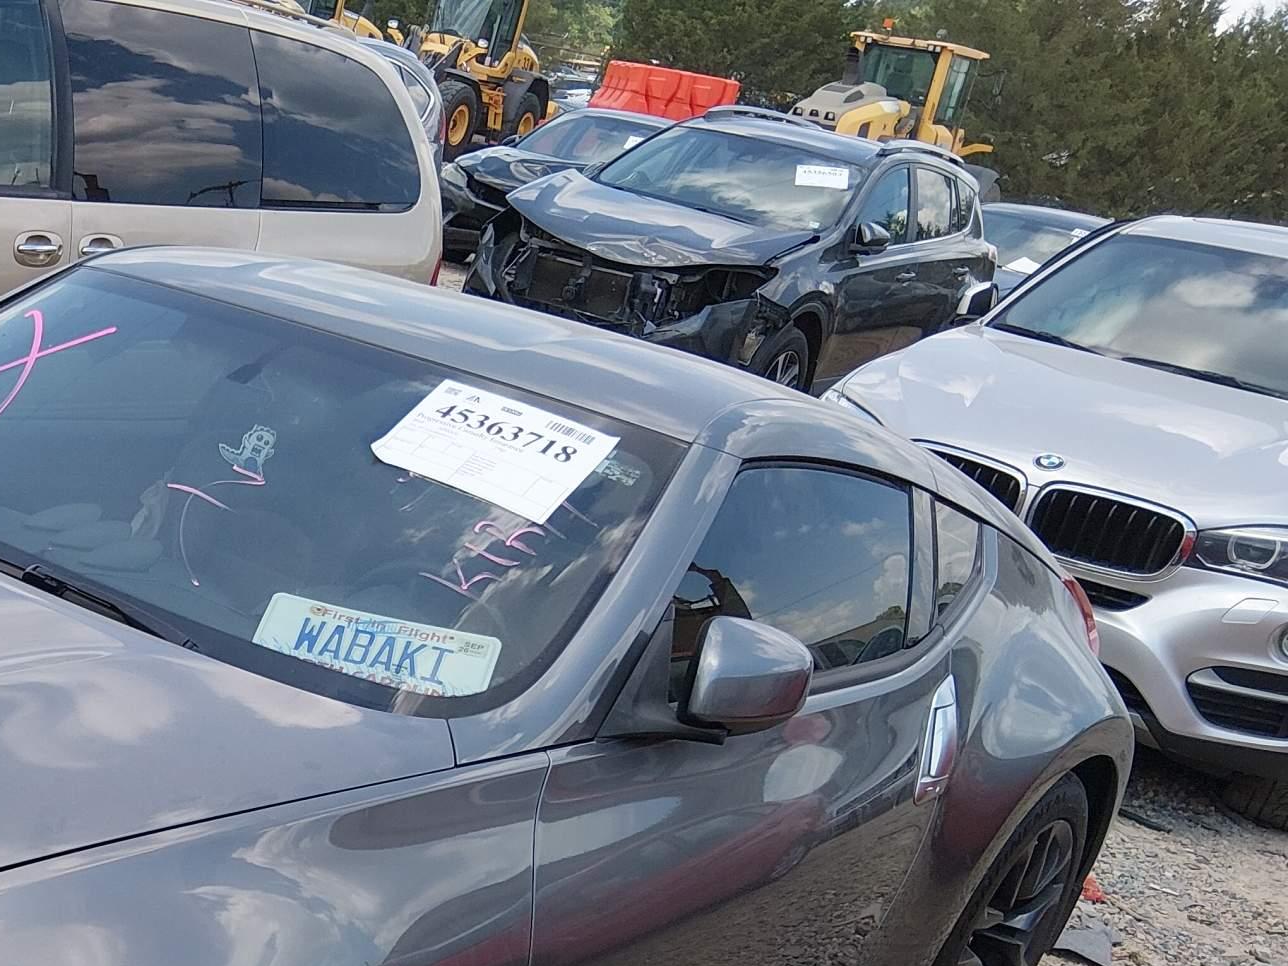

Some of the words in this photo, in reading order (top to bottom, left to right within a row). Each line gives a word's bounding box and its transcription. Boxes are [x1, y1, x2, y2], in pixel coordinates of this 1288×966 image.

[435, 404, 578, 463] 45363718
[321, 607, 361, 625] First
[398, 624, 449, 645] Flight
[464, 641, 485, 651] SEP
[293, 617, 454, 685] WABAKI
